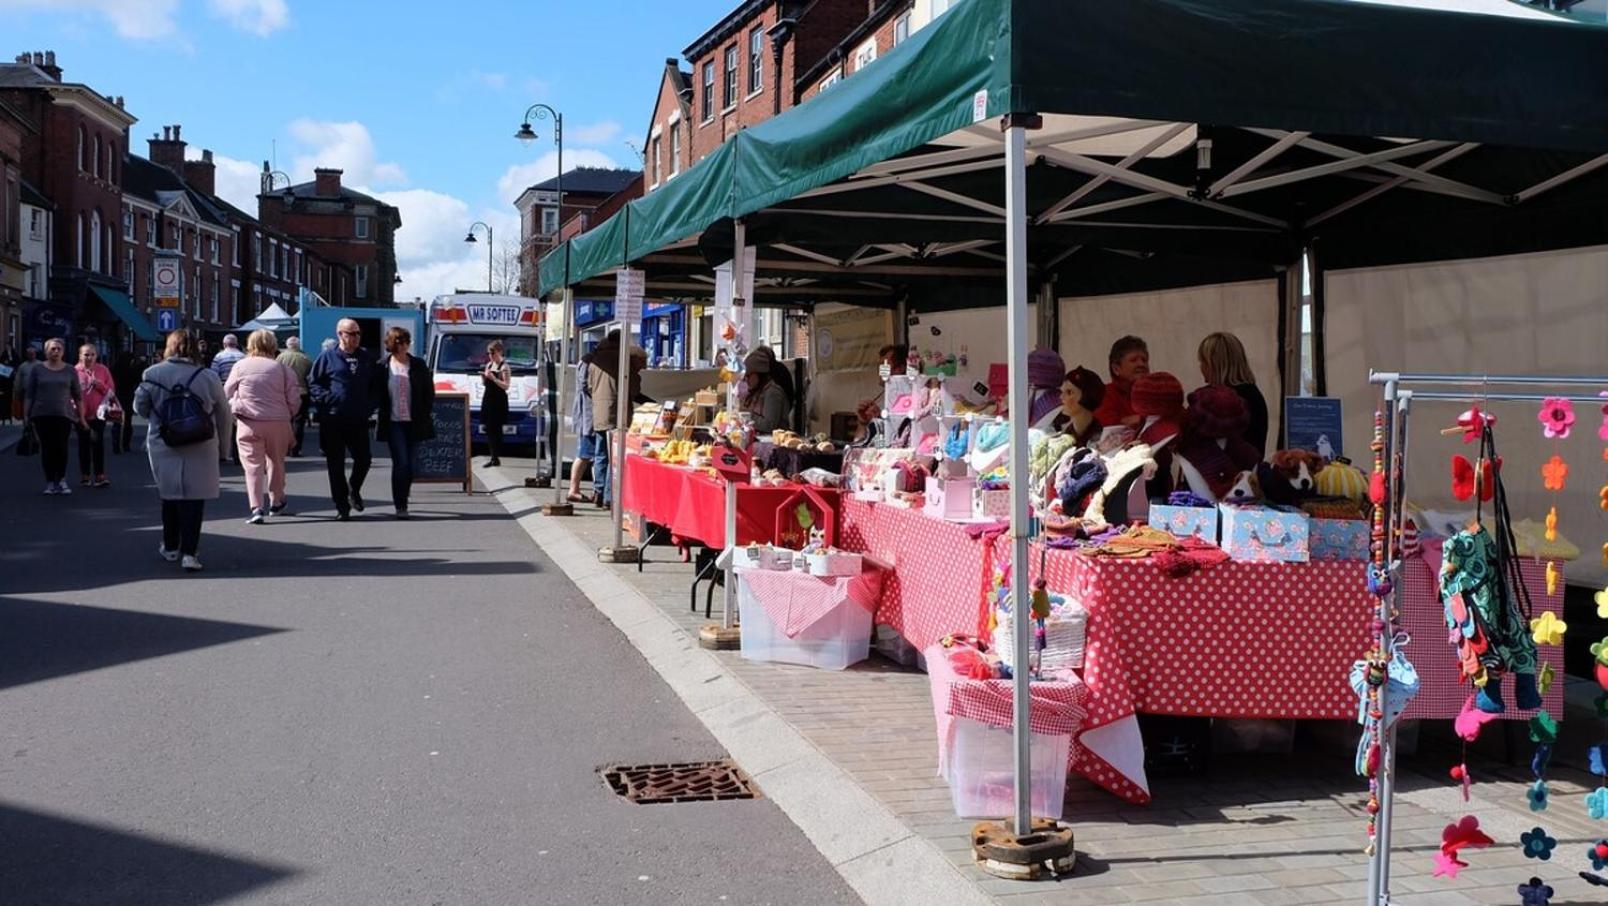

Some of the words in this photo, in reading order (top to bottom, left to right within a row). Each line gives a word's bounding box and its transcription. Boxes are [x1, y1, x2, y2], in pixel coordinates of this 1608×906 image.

[473, 307, 485, 320] MR
[487, 308, 516, 322] SOFTEE
[423, 459, 453, 473] BEEF
